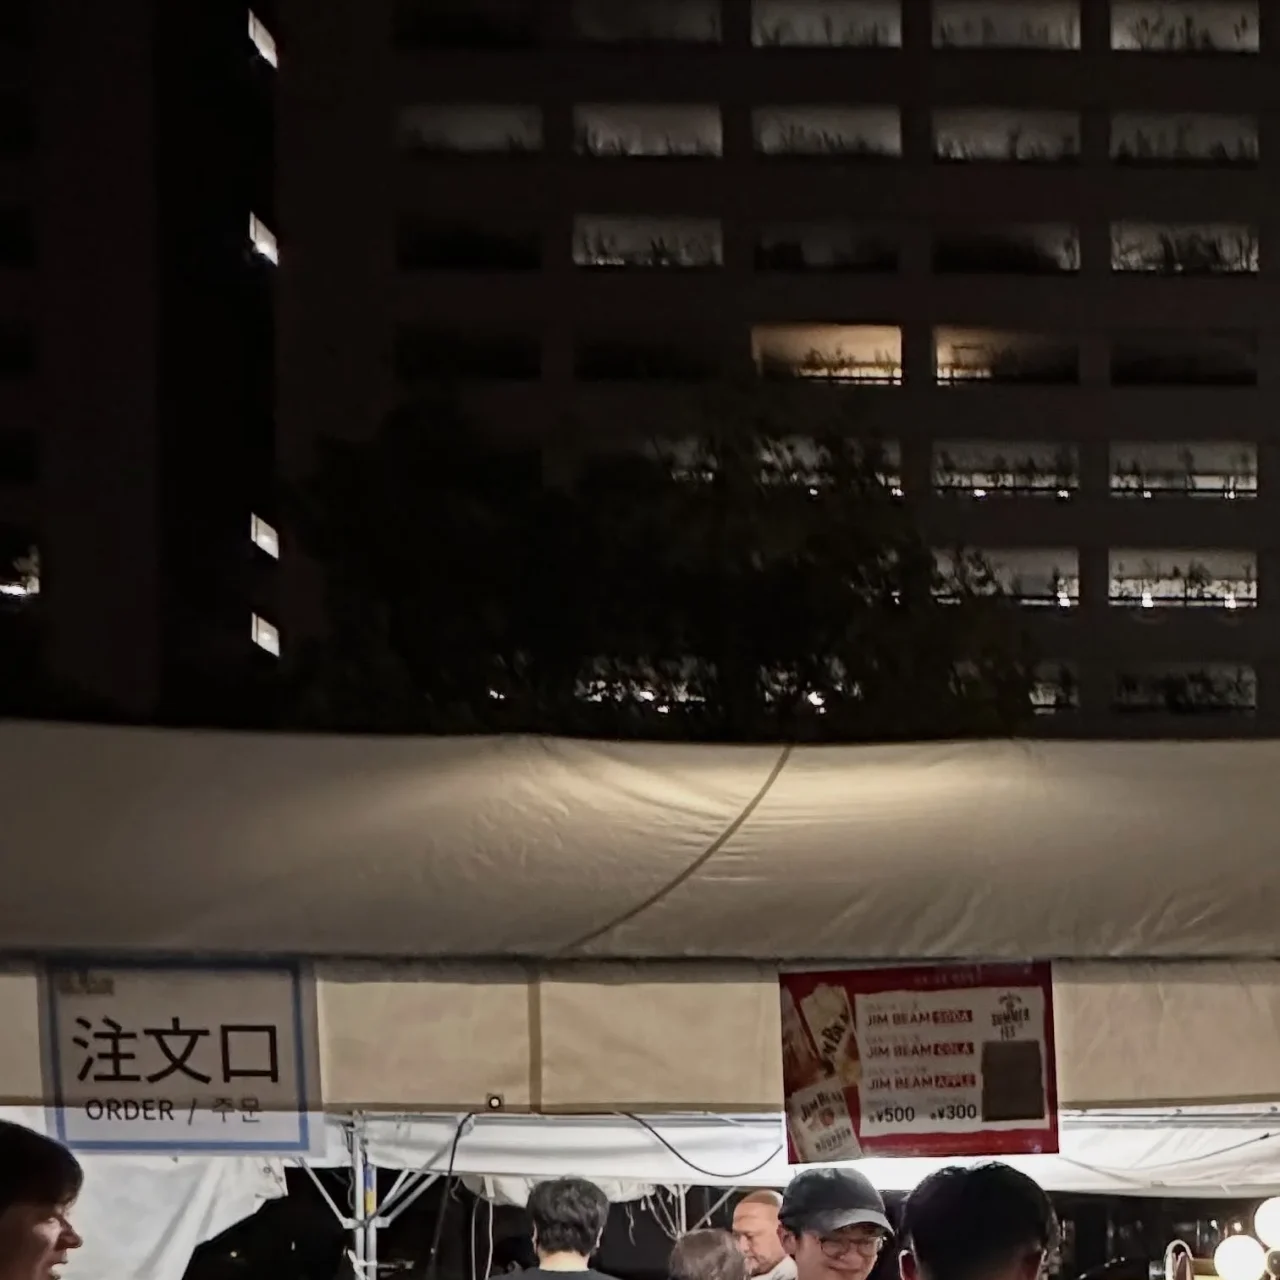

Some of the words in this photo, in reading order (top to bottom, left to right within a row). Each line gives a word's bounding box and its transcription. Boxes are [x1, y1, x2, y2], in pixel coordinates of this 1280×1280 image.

[867, 1014, 889, 1027] JIM
[892, 1011, 931, 1026] BEAM
[72, 1015, 279, 1085] 注文口
[867, 1046, 889, 1059] JIM
[893, 1043, 932, 1057] BEAM
[869, 1078, 891, 1091] JIM
[895, 1075, 933, 1090] BEAM
[85, 1097, 175, 1122] ORDER
[187, 1098, 197, 1126] /
[211, 1097, 263, 1124] 주문
